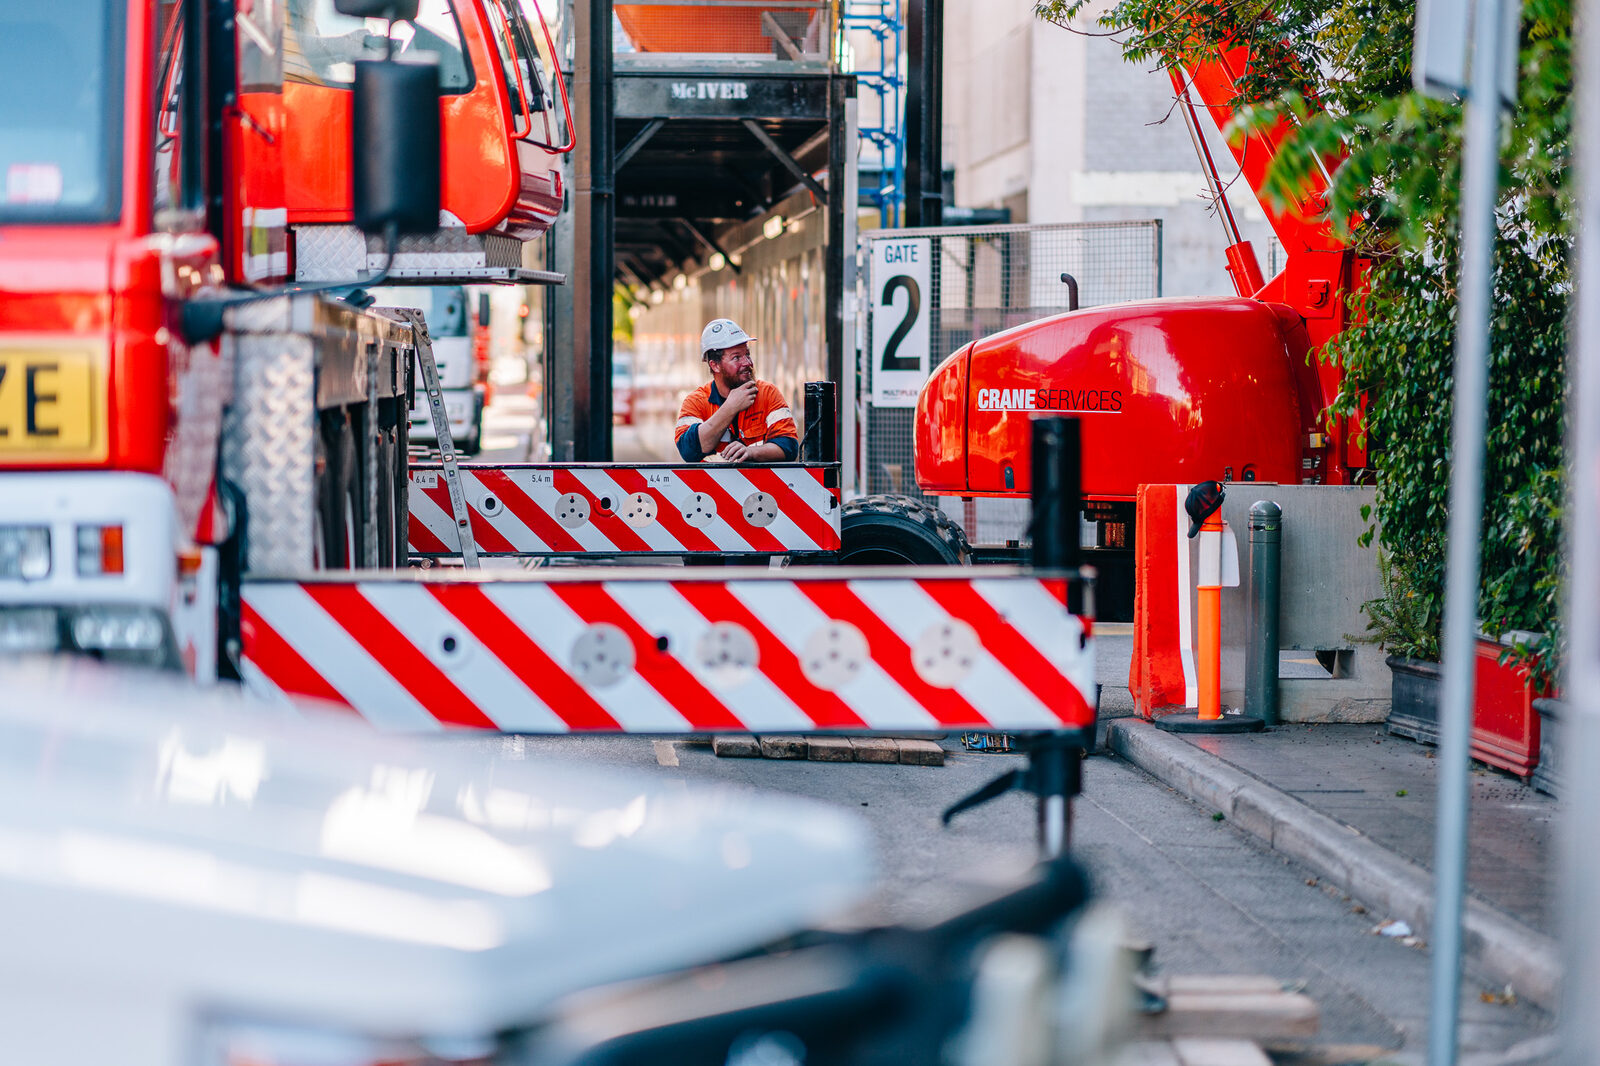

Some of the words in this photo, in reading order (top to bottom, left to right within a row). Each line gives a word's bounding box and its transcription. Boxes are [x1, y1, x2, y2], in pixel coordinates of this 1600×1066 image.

[884, 244, 919, 263] GATE
[881, 274, 921, 371] 2
[0, 363, 60, 437] E
